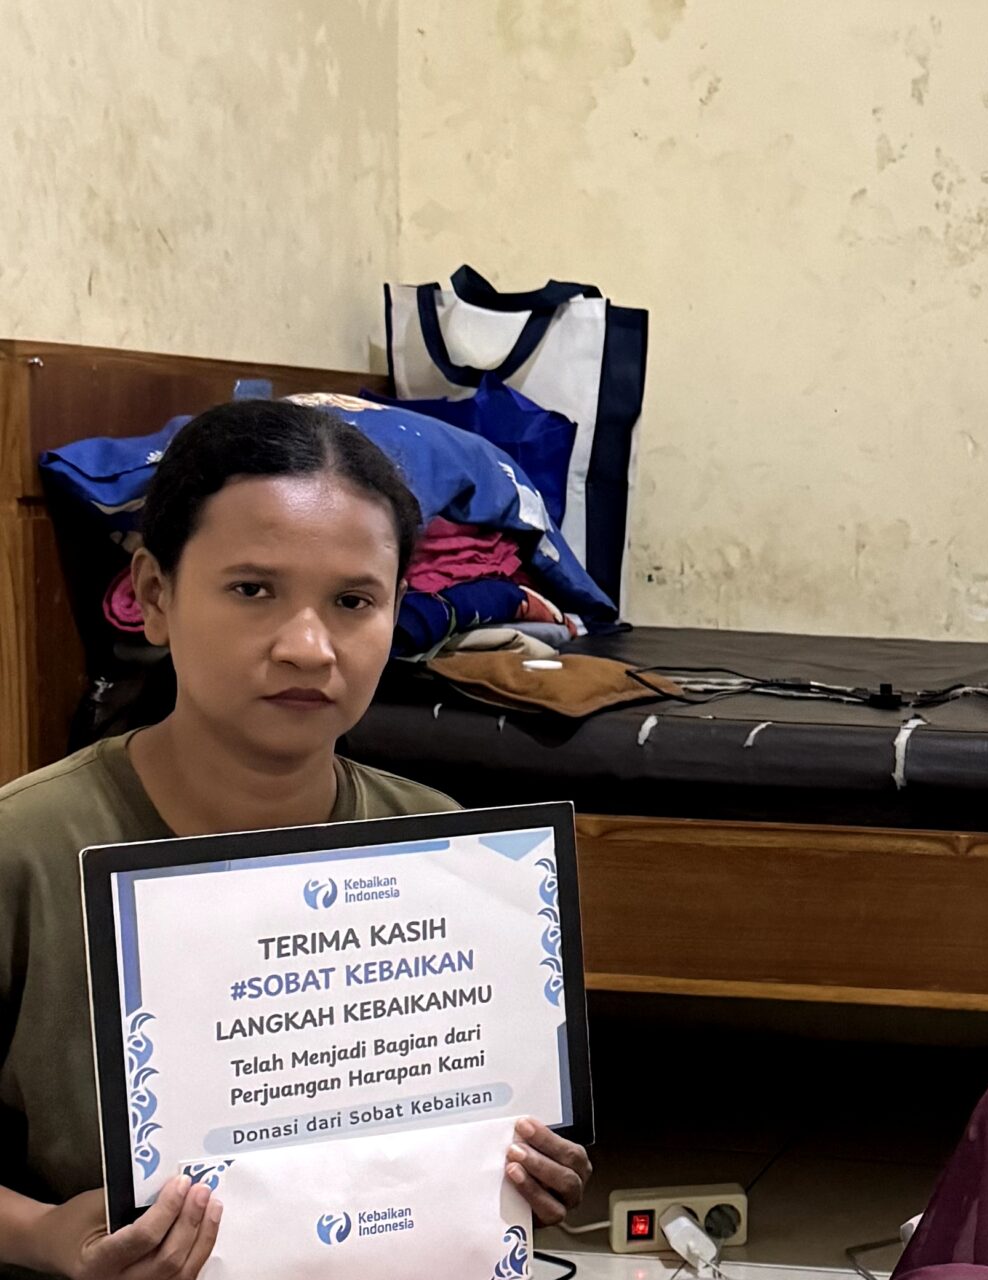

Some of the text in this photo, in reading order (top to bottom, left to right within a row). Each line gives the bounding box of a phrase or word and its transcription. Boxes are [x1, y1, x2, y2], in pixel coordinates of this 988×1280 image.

[344, 876, 397, 891] Kebaikan
[344, 887, 400, 904] Indonesia
[258, 917, 447, 960] TERIMA KASIH
[230, 949, 475, 1001] #SOBAT KEBAIKAN
[216, 985, 493, 1041] LANGKAH KEBAIKANMU
[230, 1024, 482, 1077] Telah Menjadi Bagian dari
[230, 1050, 486, 1106] Perjuangan Harapan Kami
[233, 1090, 493, 1145] Donasi dari Sobat Kebaikan
[358, 1207, 412, 1225] Kebaikan
[359, 1218, 415, 1237] Indonesia
